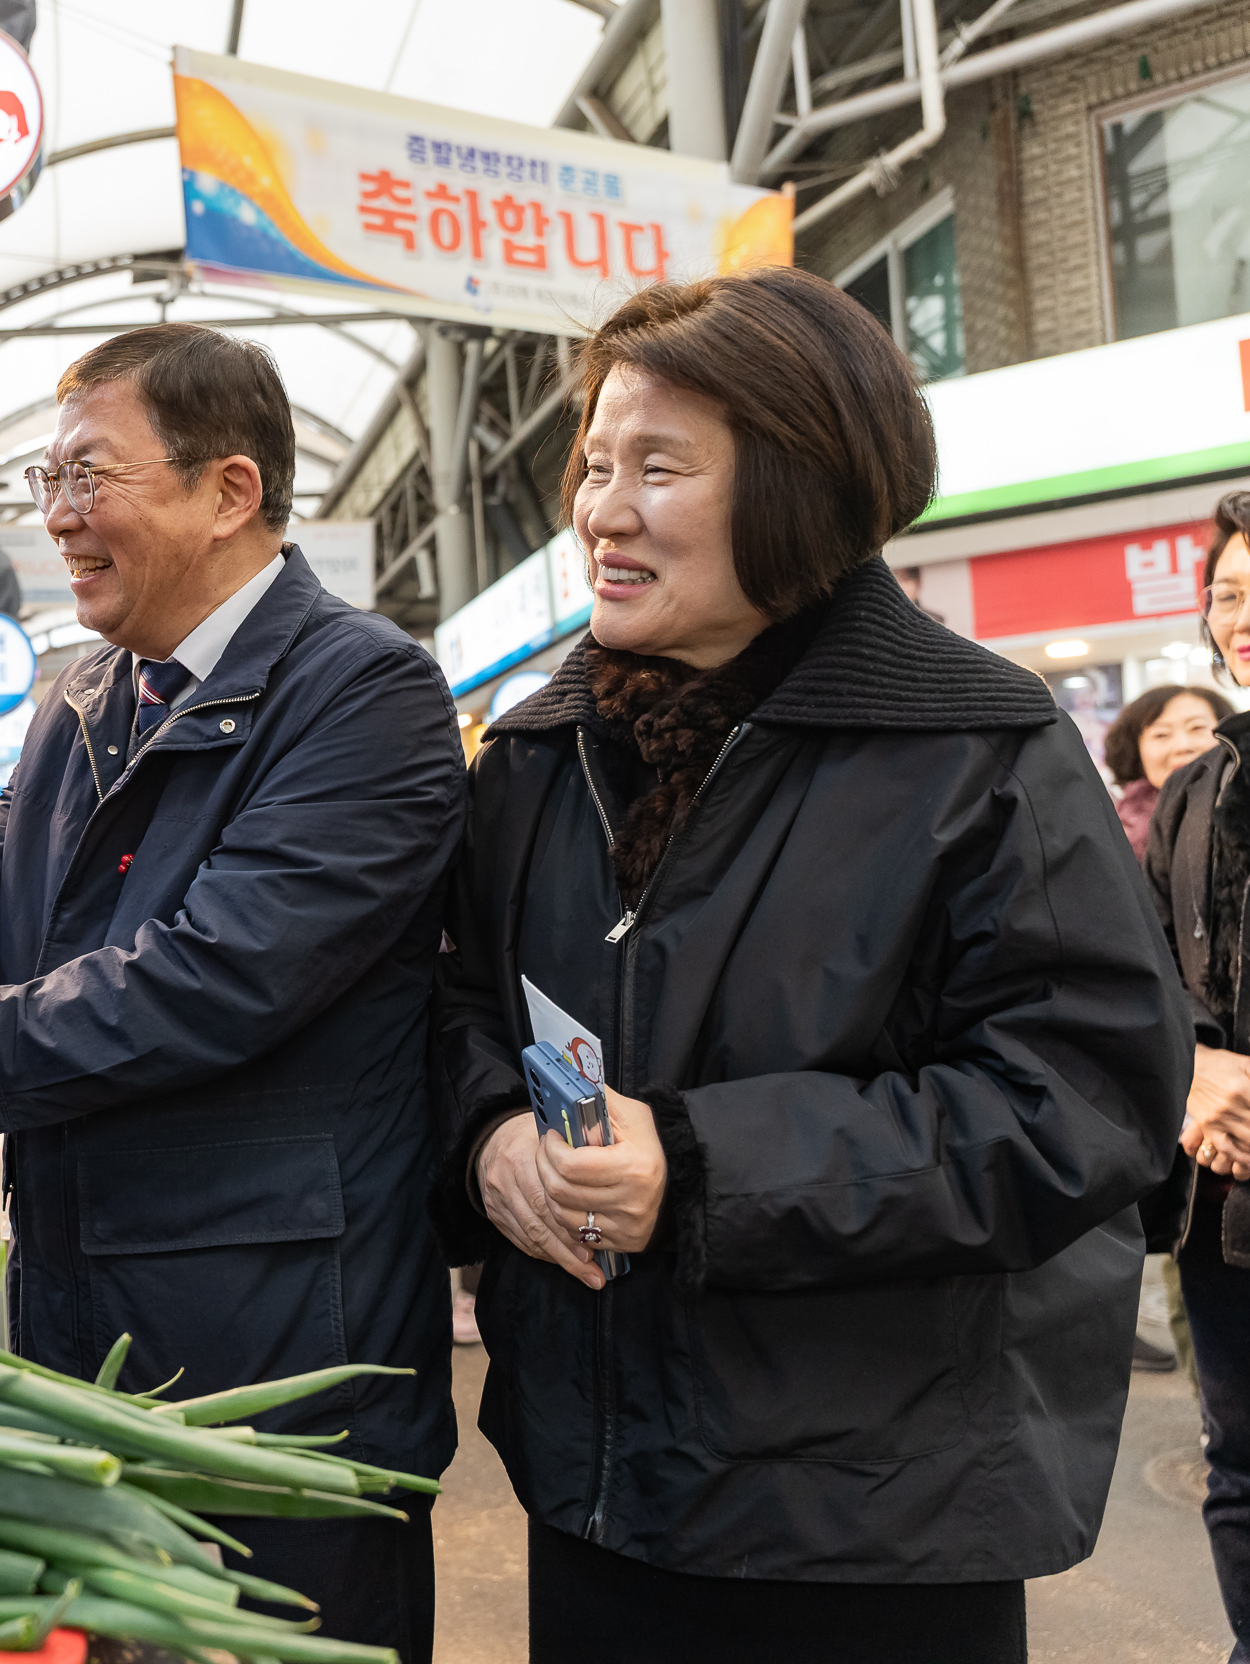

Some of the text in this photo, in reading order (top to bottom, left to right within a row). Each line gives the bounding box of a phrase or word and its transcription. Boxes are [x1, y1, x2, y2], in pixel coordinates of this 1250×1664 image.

[405, 133, 550, 187] 증발냉방장치
[356, 168, 672, 284] 축하합니다
[1124, 534, 1206, 616] 발
